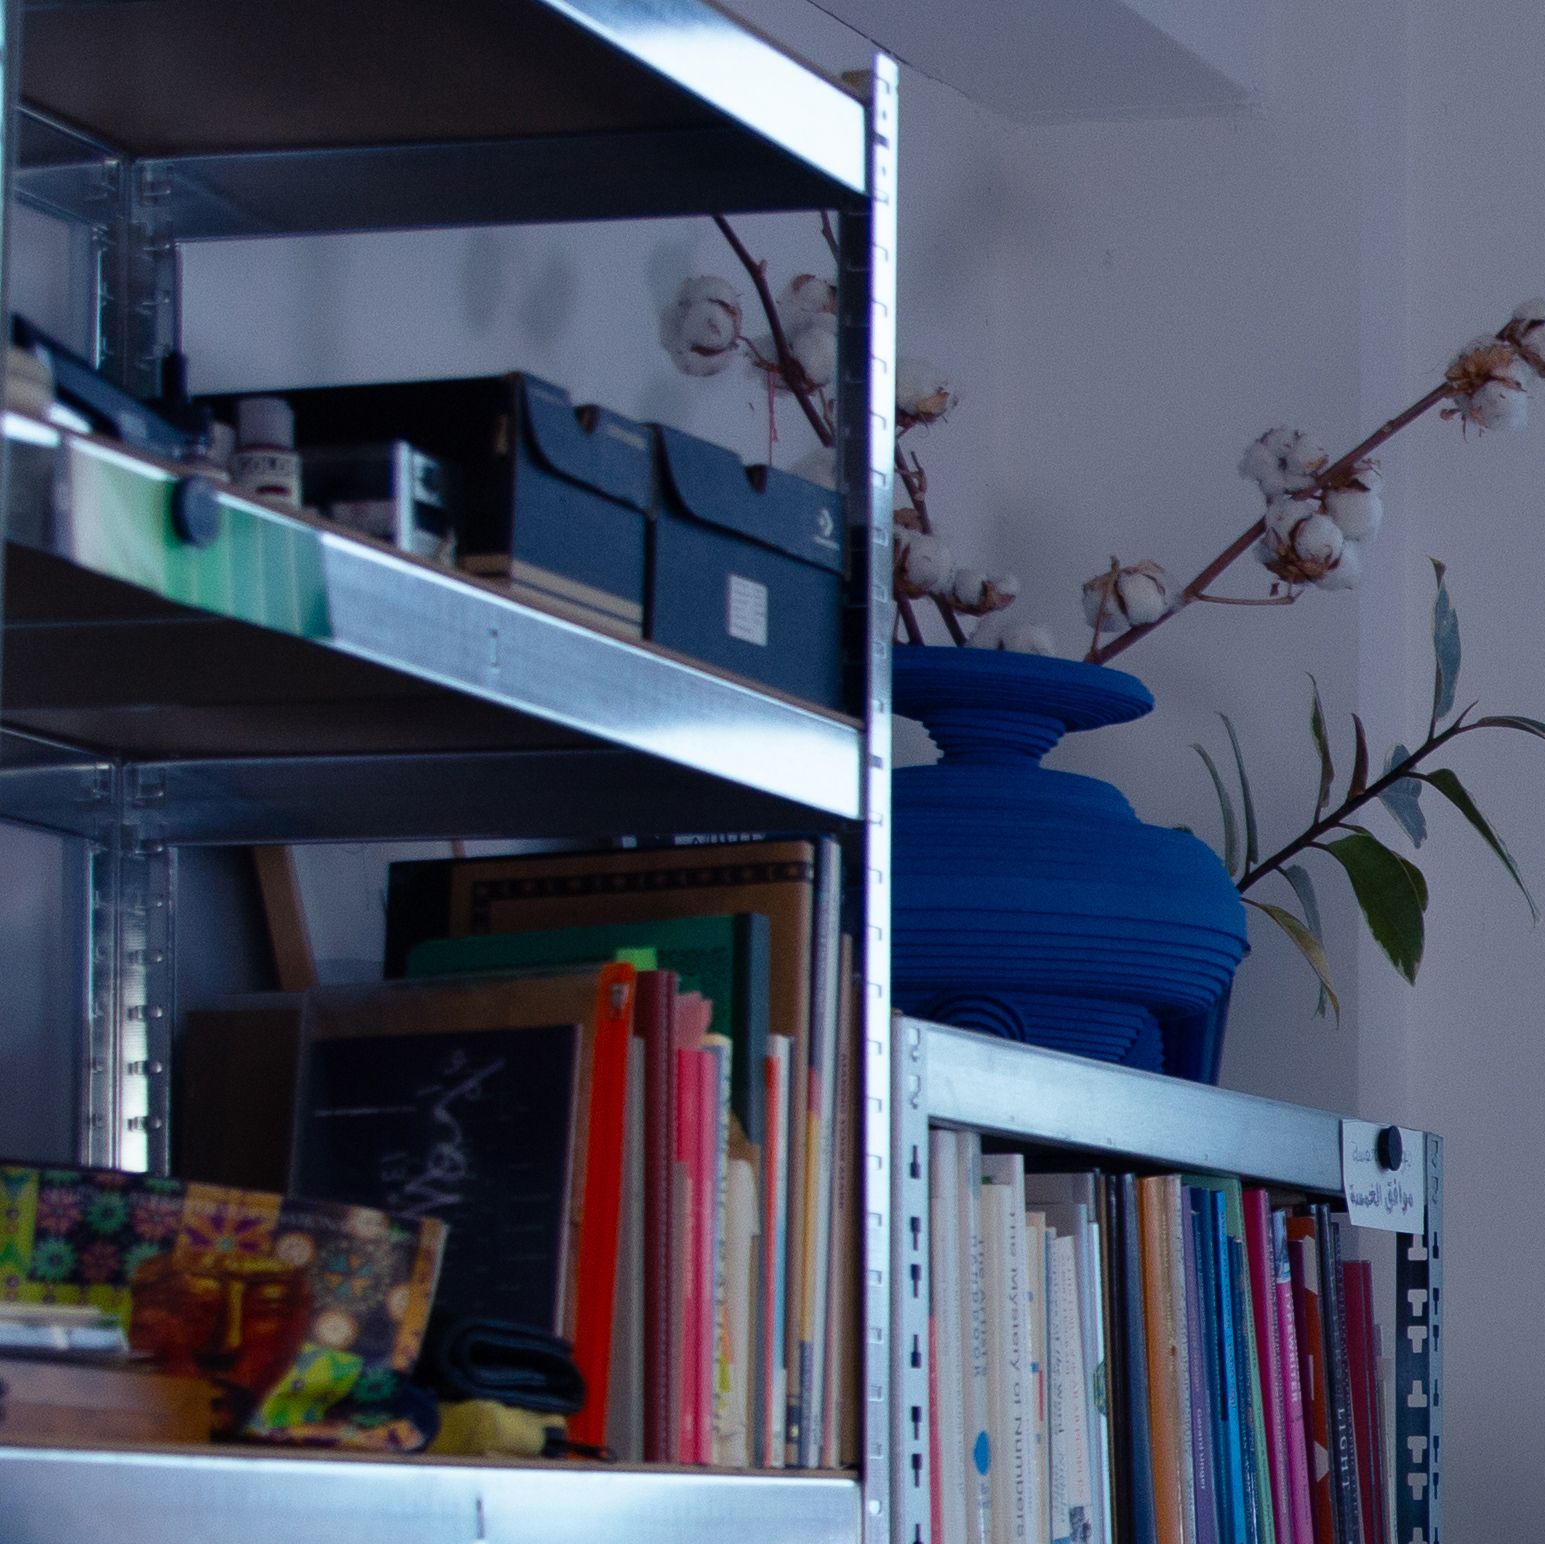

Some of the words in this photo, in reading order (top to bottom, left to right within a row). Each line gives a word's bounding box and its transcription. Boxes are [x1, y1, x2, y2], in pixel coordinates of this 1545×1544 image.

[1008, 1211, 1018, 1257] The
[967, 1234, 982, 1377] HANDBOOK
[1006, 1266, 1021, 1373] Mystery
[1053, 1347, 1063, 1379] the
[1281, 1291, 1300, 1403] TYPEWRITER
[1012, 1380, 1022, 1406] of
[1054, 1383, 1065, 1434] Word
[1195, 1407, 1204, 1452] Gerard
[1336, 1406, 1350, 1492] LIGHT
[1013, 1415, 1025, 1538] Numbers
[1072, 1427, 1085, 1498] PEOPLES
[1197, 1454, 1206, 1491] Unger
